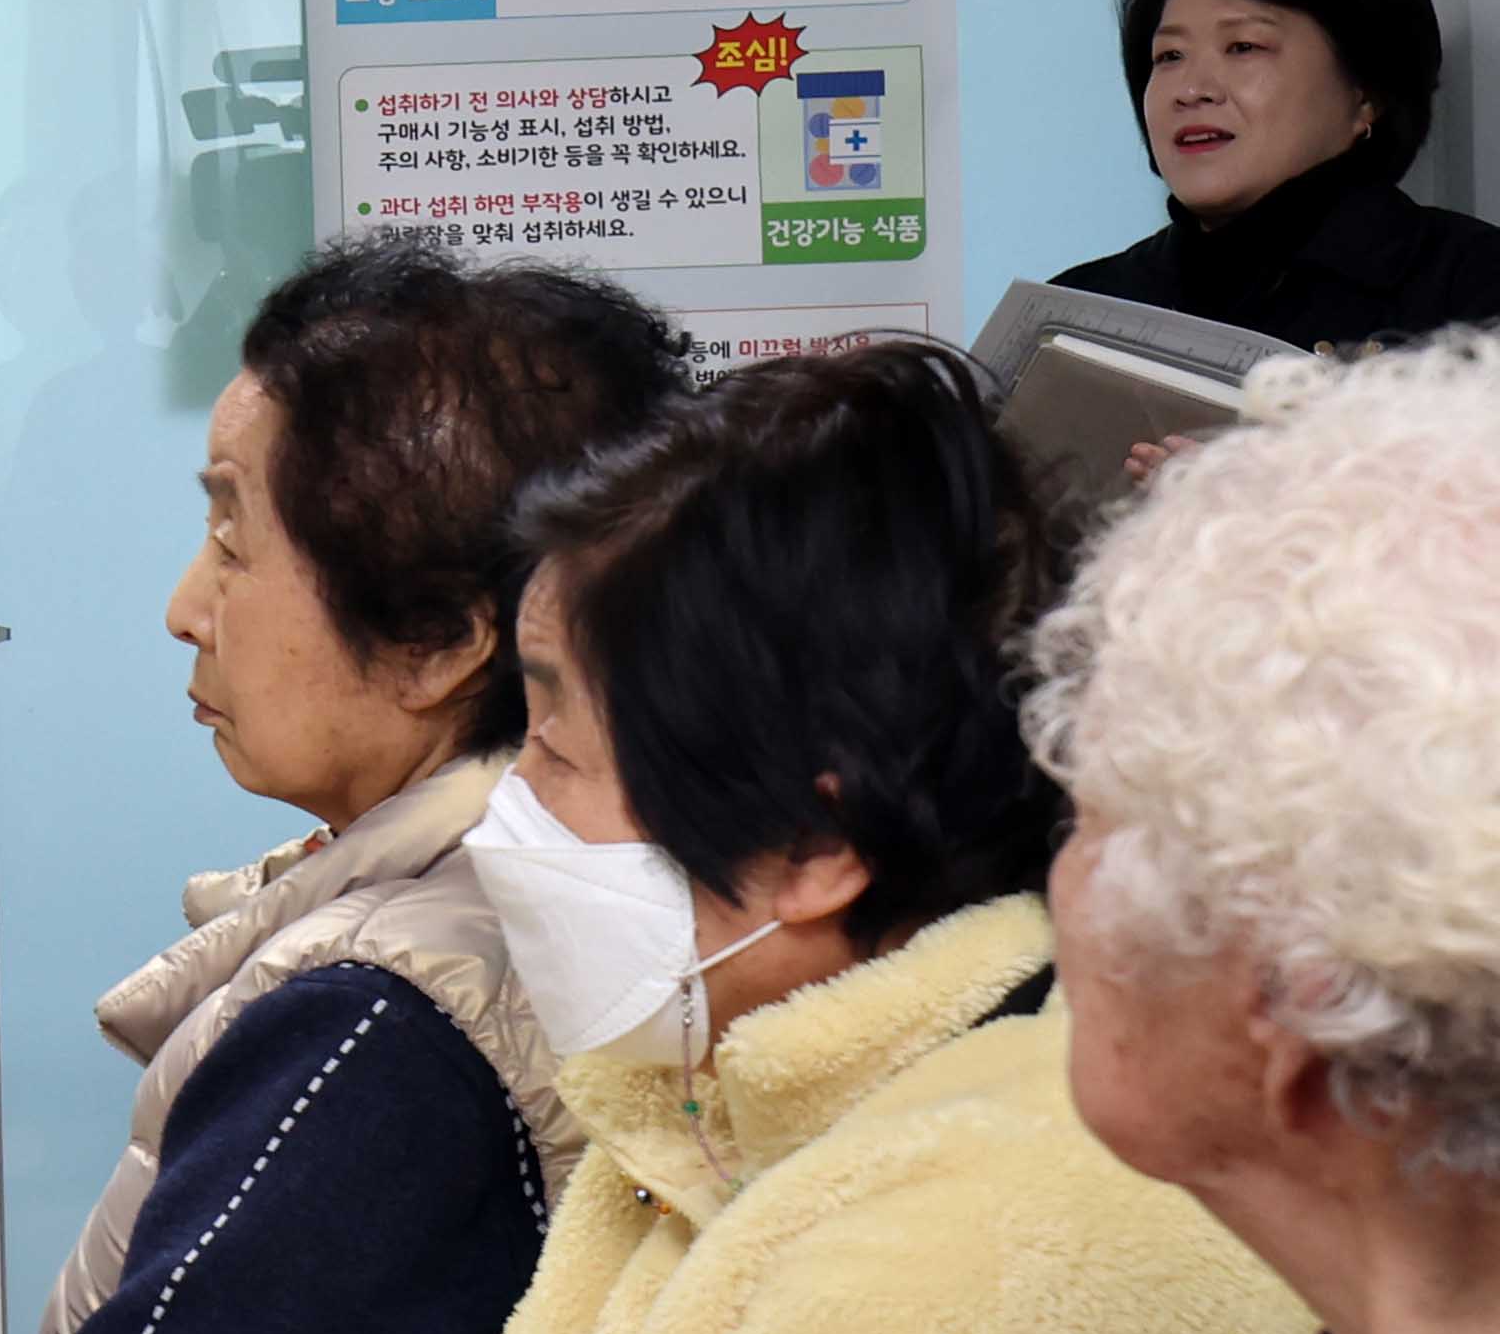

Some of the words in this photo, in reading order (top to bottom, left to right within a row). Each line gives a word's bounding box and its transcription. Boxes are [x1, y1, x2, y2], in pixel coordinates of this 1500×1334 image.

[715, 37, 788, 73] 조심!
[377, 92, 460, 117] 섭취하기
[468, 91, 489, 114] 전
[495, 88, 560, 109] 의사와
[566, 85, 673, 111] 상담하시고
[377, 121, 440, 144] 구매시
[447, 118, 510, 143] 기능성
[517, 117, 567, 138] 표시,
[573, 115, 615, 139] 섭취
[622, 113, 672, 137] 방법,
[377, 149, 418, 173] 주의
[424, 148, 471, 172] 사항,
[475, 145, 559, 168] 소비기한
[563, 143, 605, 168] 등을
[610, 142, 632, 166] 꼭
[637, 139, 747, 164] 확인하세요.
[379, 197, 421, 217] 과다
[427, 195, 468, 219] 섭취
[473, 193, 515, 216] 하면
[521, 190, 604, 214] 부작용이
[609, 188, 651, 213] 생길
[657, 188, 679, 210] 수
[684, 184, 747, 210] 있으니
[472, 222, 514, 246] 맞춰
[522, 218, 635, 244] 섭취하세요.
[766, 217, 865, 247] 건강기능
[872, 214, 922, 243] 식품
